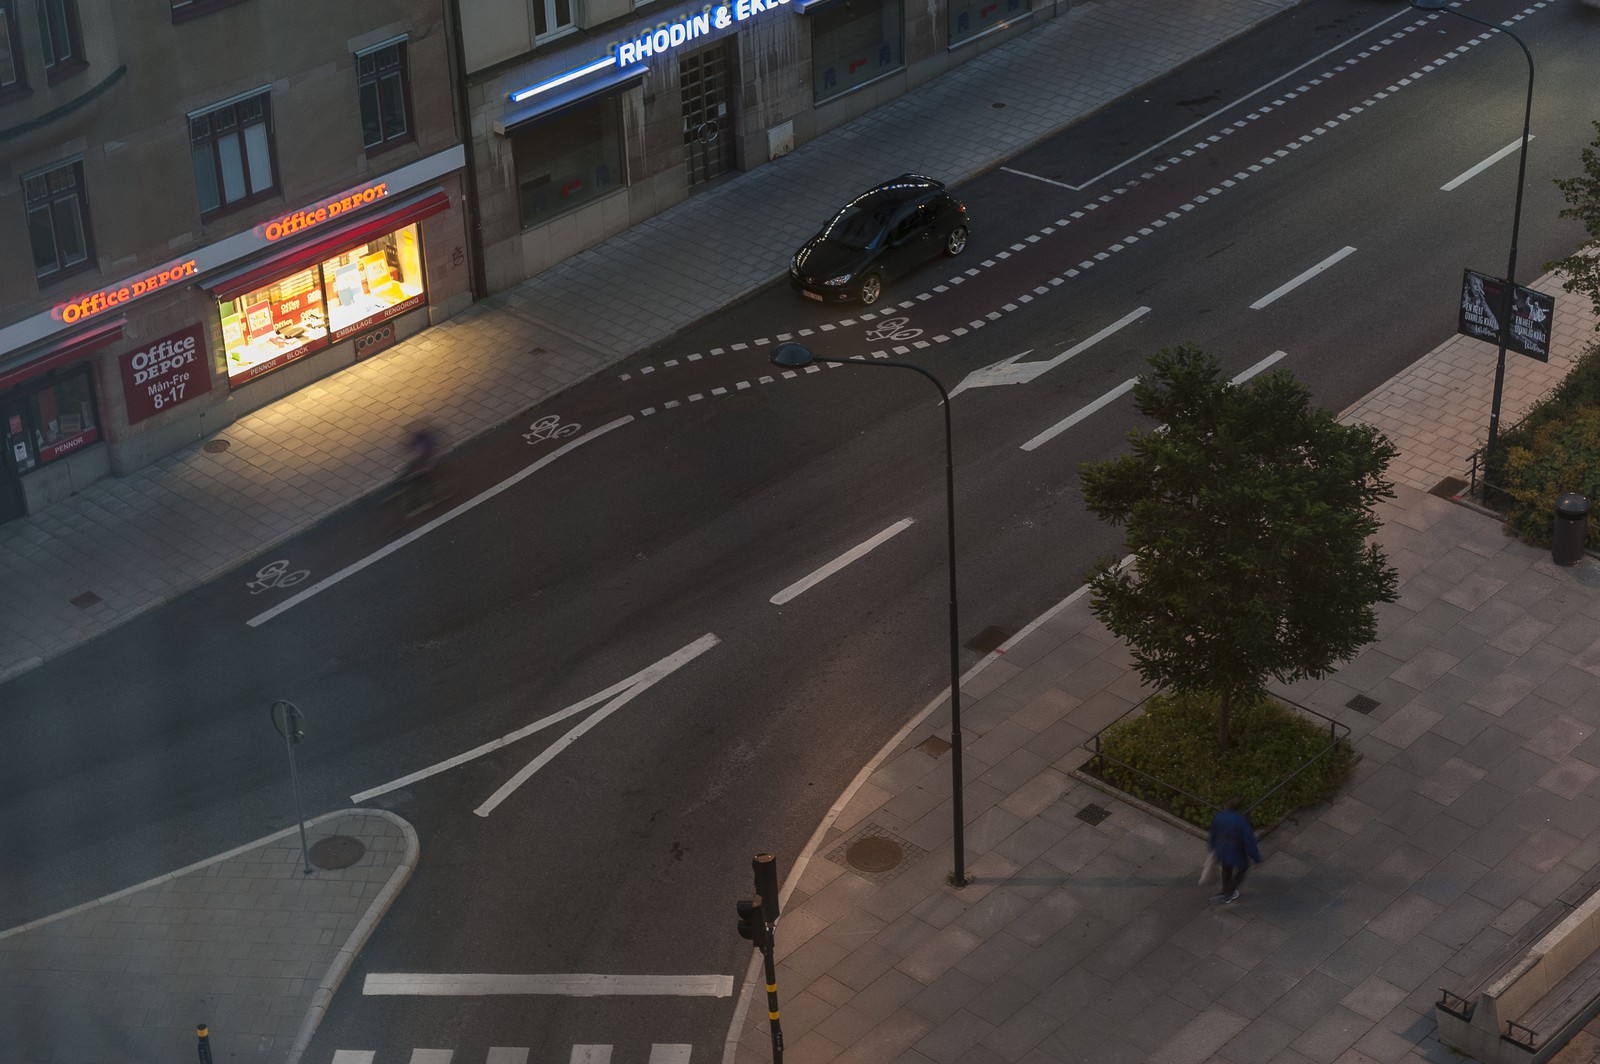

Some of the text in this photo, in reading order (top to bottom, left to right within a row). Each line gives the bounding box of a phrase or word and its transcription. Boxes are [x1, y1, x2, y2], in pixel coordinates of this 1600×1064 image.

[617, 0, 791, 68] RHODIN & EKL
[265, 207, 327, 241] Office
[62, 287, 130, 324] Office
[281, 300, 300, 311] Office
[336, 317, 373, 338] EMBALLAGE
[131, 336, 195, 370] Office
[250, 346, 309, 376] PENNOR BLOCK
[147, 372, 190, 396] Mån-Fre
[153, 382, 186, 409] 8-17
[54, 436, 84, 454] PENNOR
